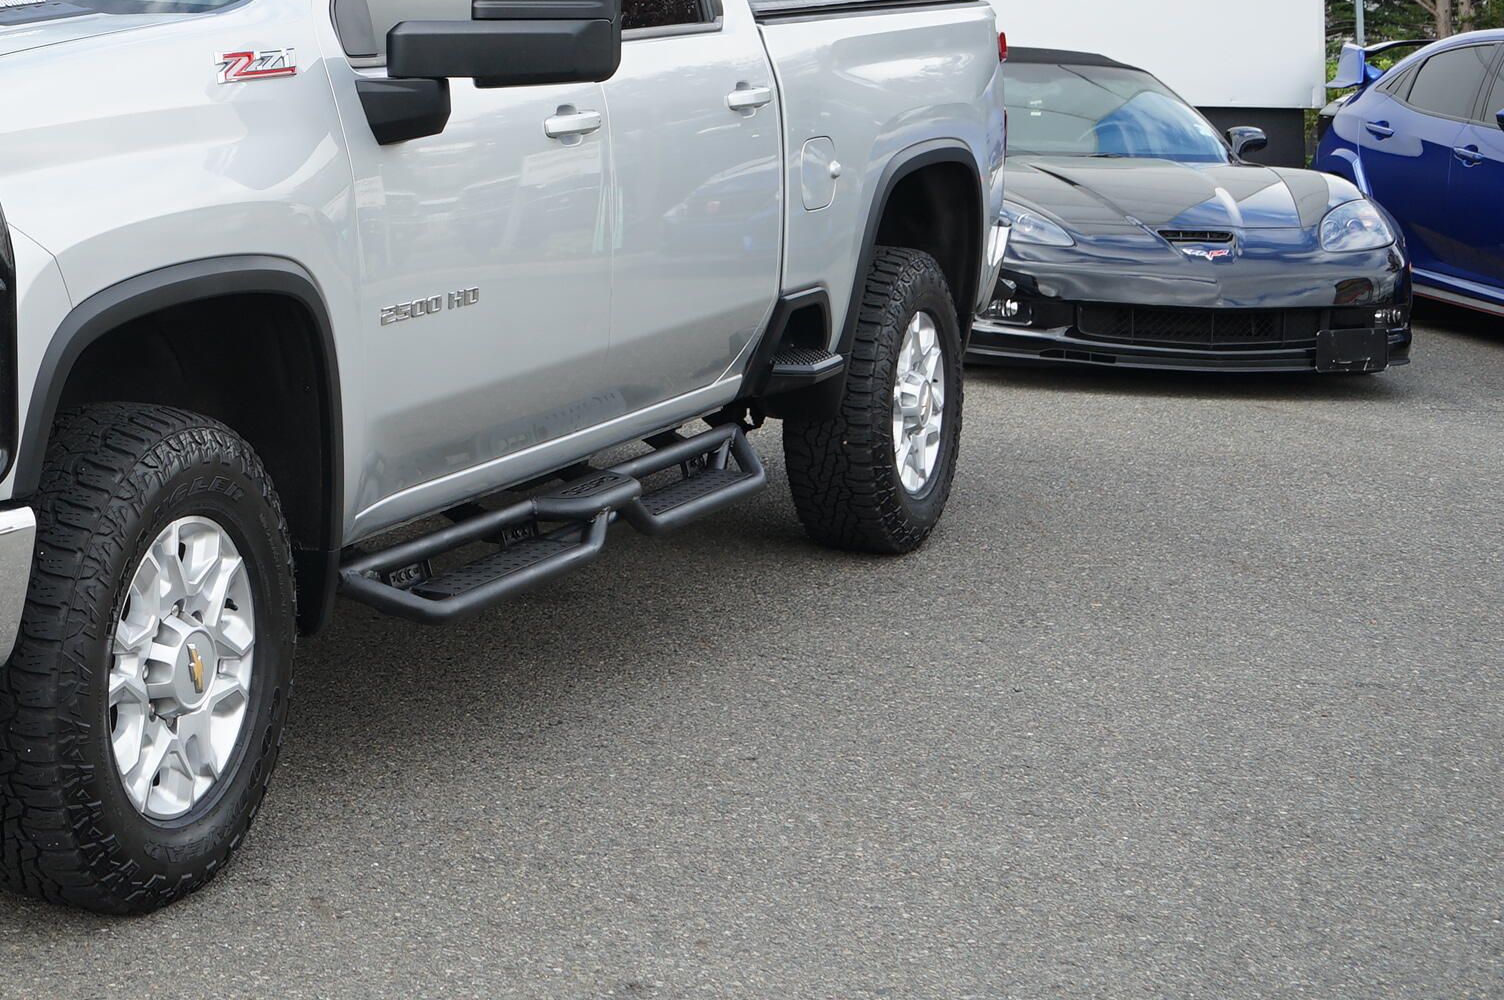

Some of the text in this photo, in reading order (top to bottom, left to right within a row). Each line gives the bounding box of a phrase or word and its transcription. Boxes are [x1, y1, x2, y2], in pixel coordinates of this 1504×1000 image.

[214, 47, 297, 84] Z71
[381, 286, 479, 326] 2500 HD
